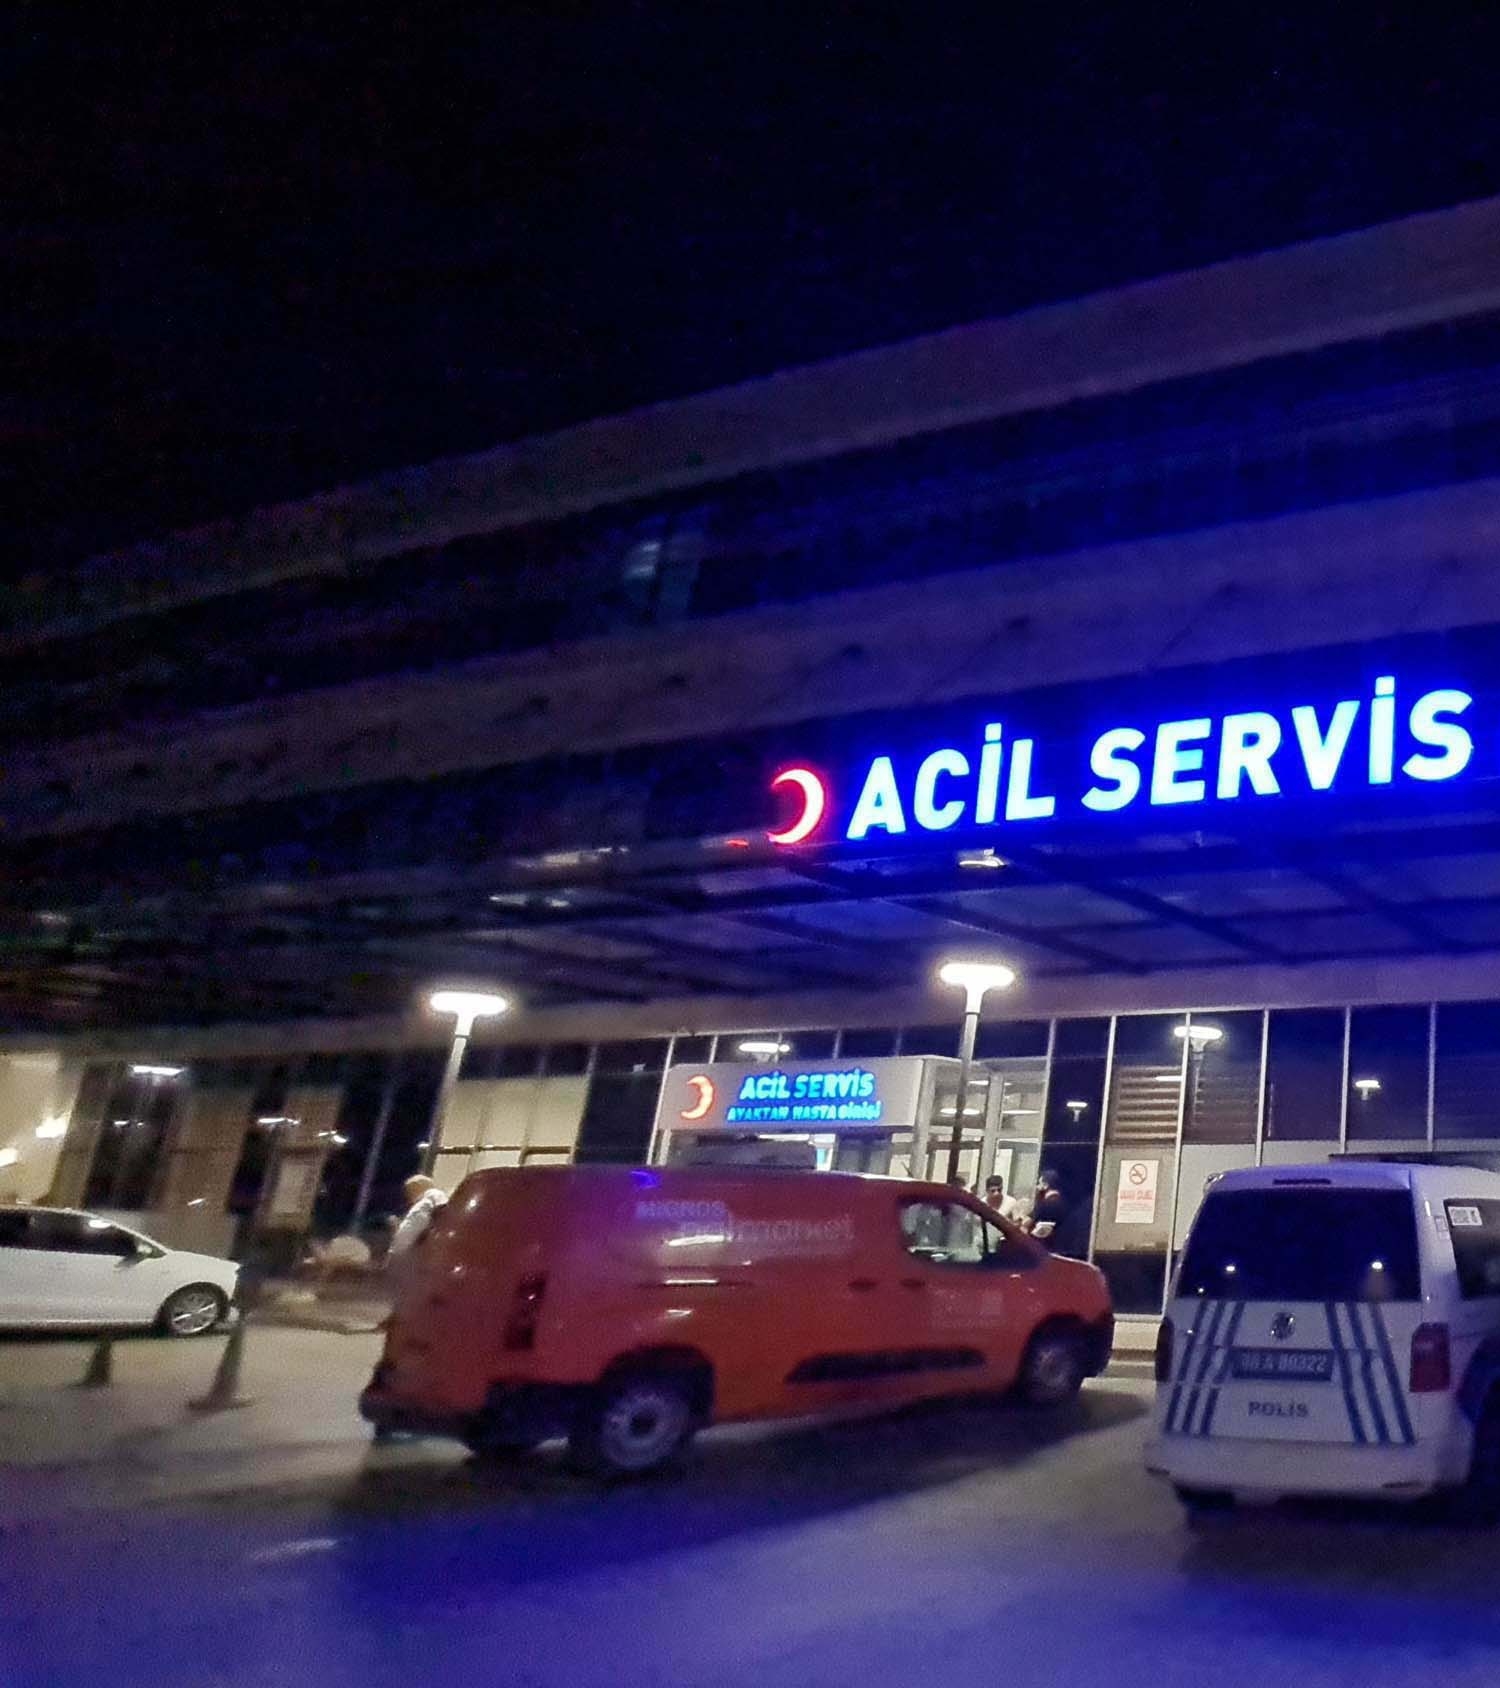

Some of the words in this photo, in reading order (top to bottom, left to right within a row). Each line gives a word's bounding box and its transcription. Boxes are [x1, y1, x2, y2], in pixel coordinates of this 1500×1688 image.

[847, 722, 1055, 840] ACİL
[1081, 676, 1474, 812] SERVİS
[739, 1071, 791, 1100] ACİL
[794, 1068, 875, 1098] SERVİS
